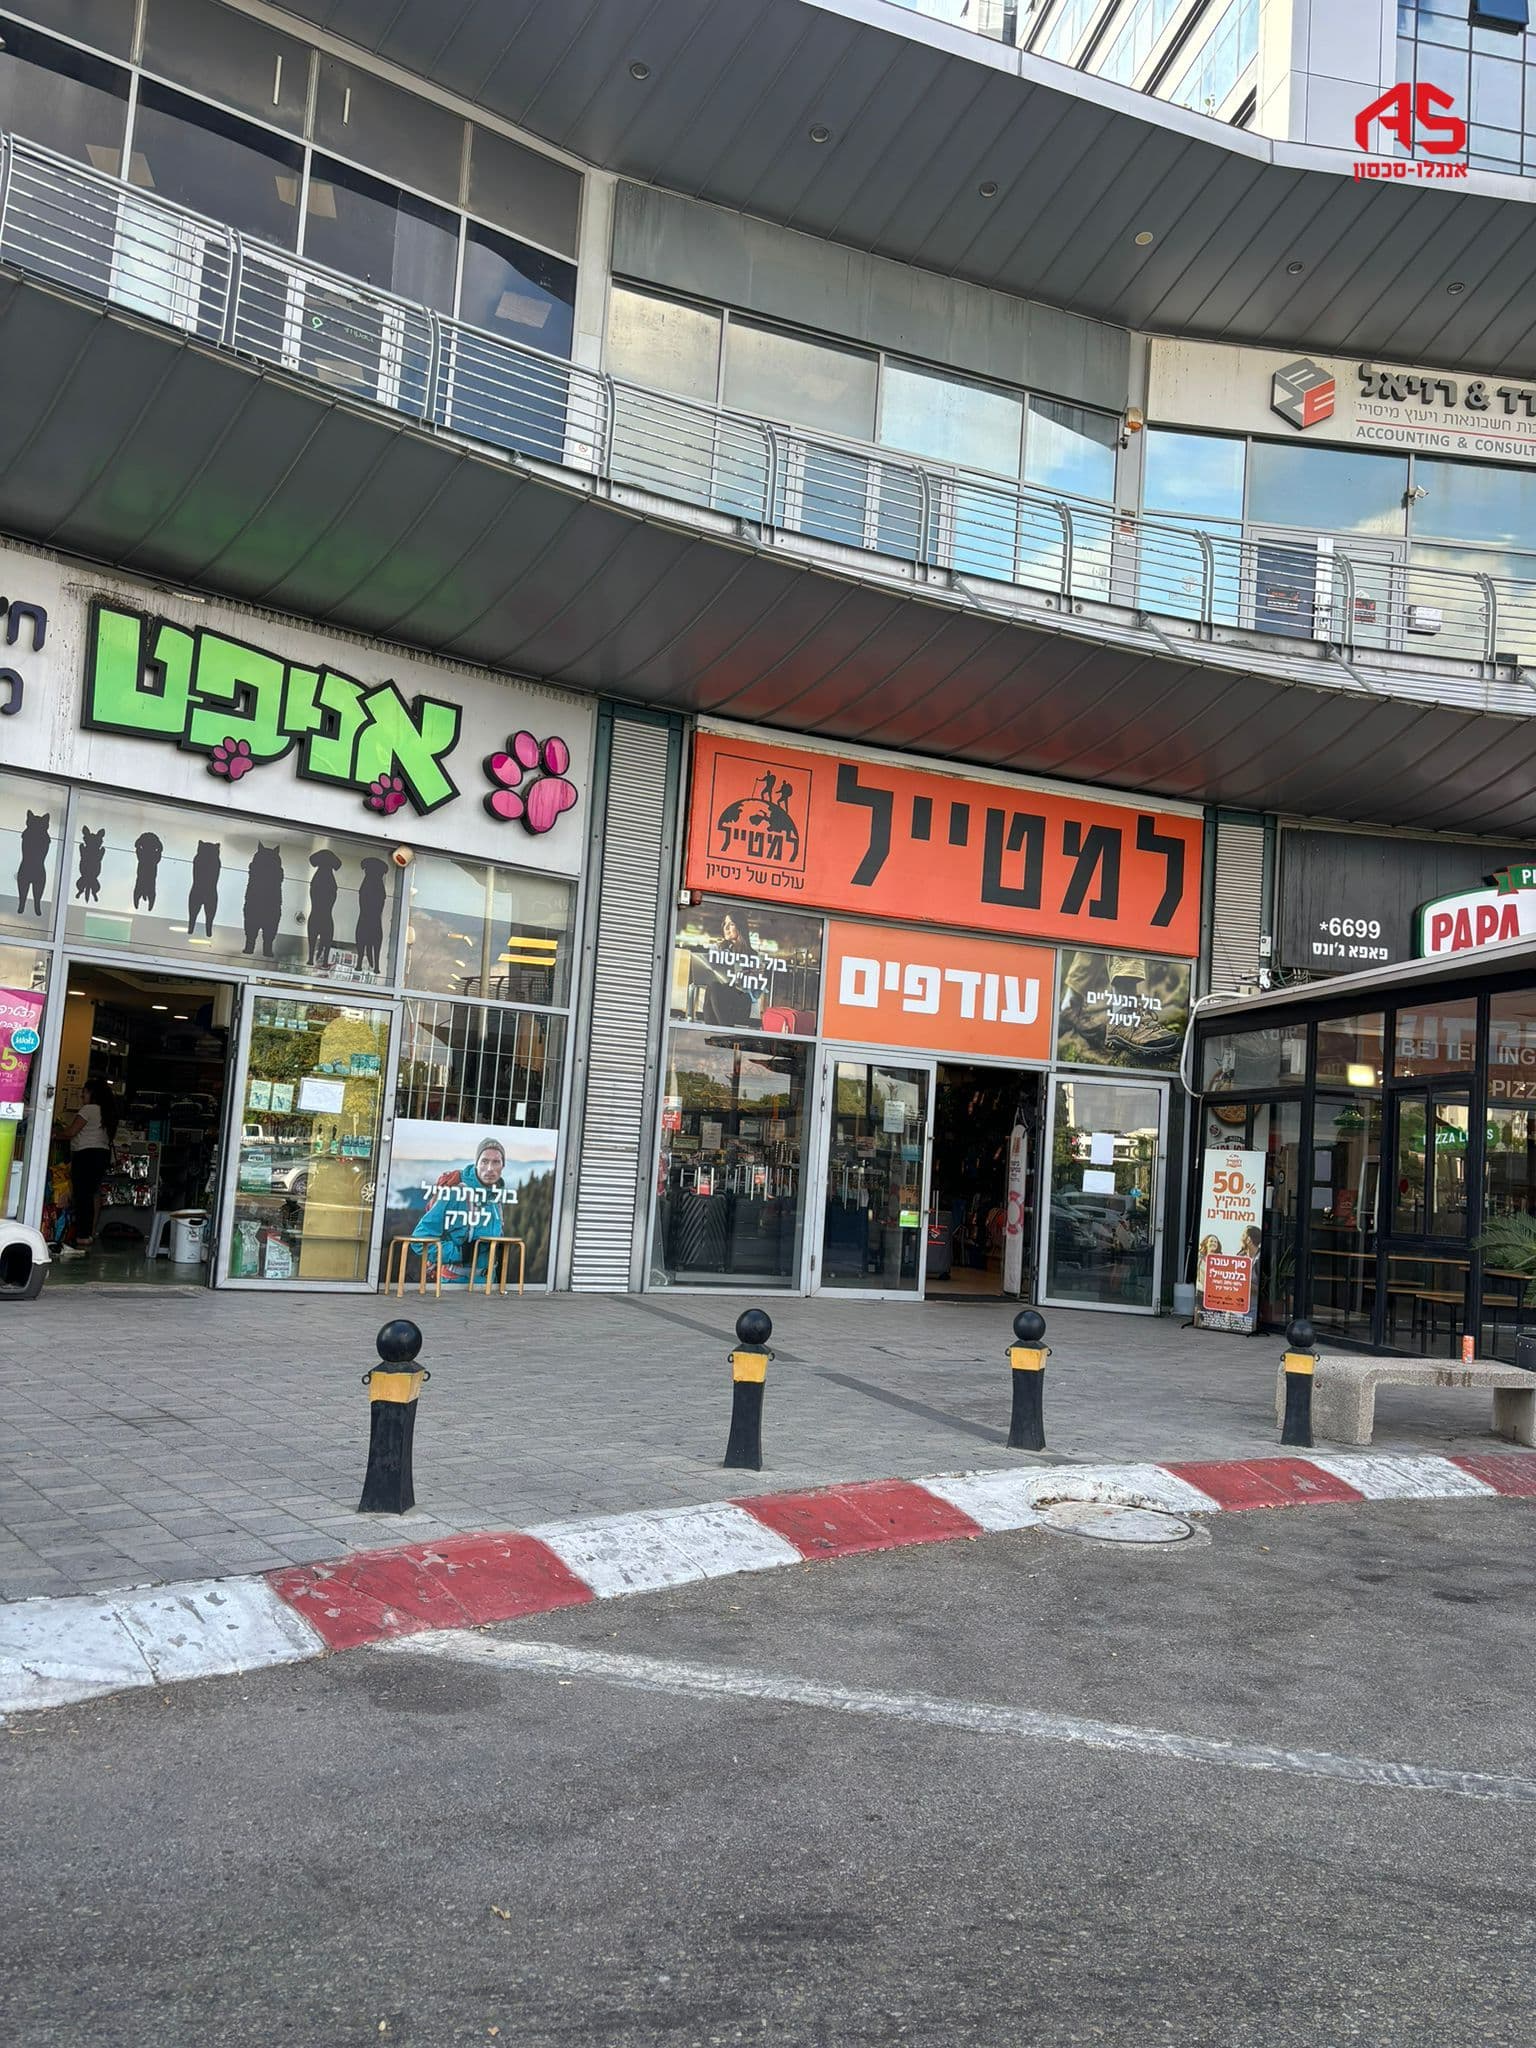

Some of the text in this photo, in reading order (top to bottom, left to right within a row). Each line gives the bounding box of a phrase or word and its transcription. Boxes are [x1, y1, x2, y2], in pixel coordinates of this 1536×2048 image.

[1358, 362, 1458, 408] רזיאל
[1464, 380, 1491, 411] &
[1404, 408, 1438, 424] ויעוץ
[1443, 411, 1511, 431] חשבונאות
[1356, 425, 1536, 457] ACCOUNTING & CONSULT
[81, 599, 462, 816] אניפט
[717, 822, 800, 862] למטייל
[836, 763, 1186, 927] למטייל
[705, 862, 805, 890] עולם של ניסיון
[1431, 903, 1521, 952] PAPA
[708, 948, 788, 973] בול הביטוח
[1312, 941, 1389, 961] פאפא ג'ונס
[839, 955, 1040, 1025] עודפים
[1086, 989, 1162, 1011] בול הנעליים
[1106, 1009, 1141, 1027] לטיול
[1400, 1038, 1476, 1061] BETTE
[421, 1181, 519, 1204] בול התרמיל
[1213, 1171, 1256, 1195] 50%
[1214, 1195, 1251, 1209] מהקיץ
[444, 1207, 492, 1230] לטרק
[1207, 1208, 1256, 1221] מאחורינו
[1210, 1257, 1246, 1271] סוף עונה
